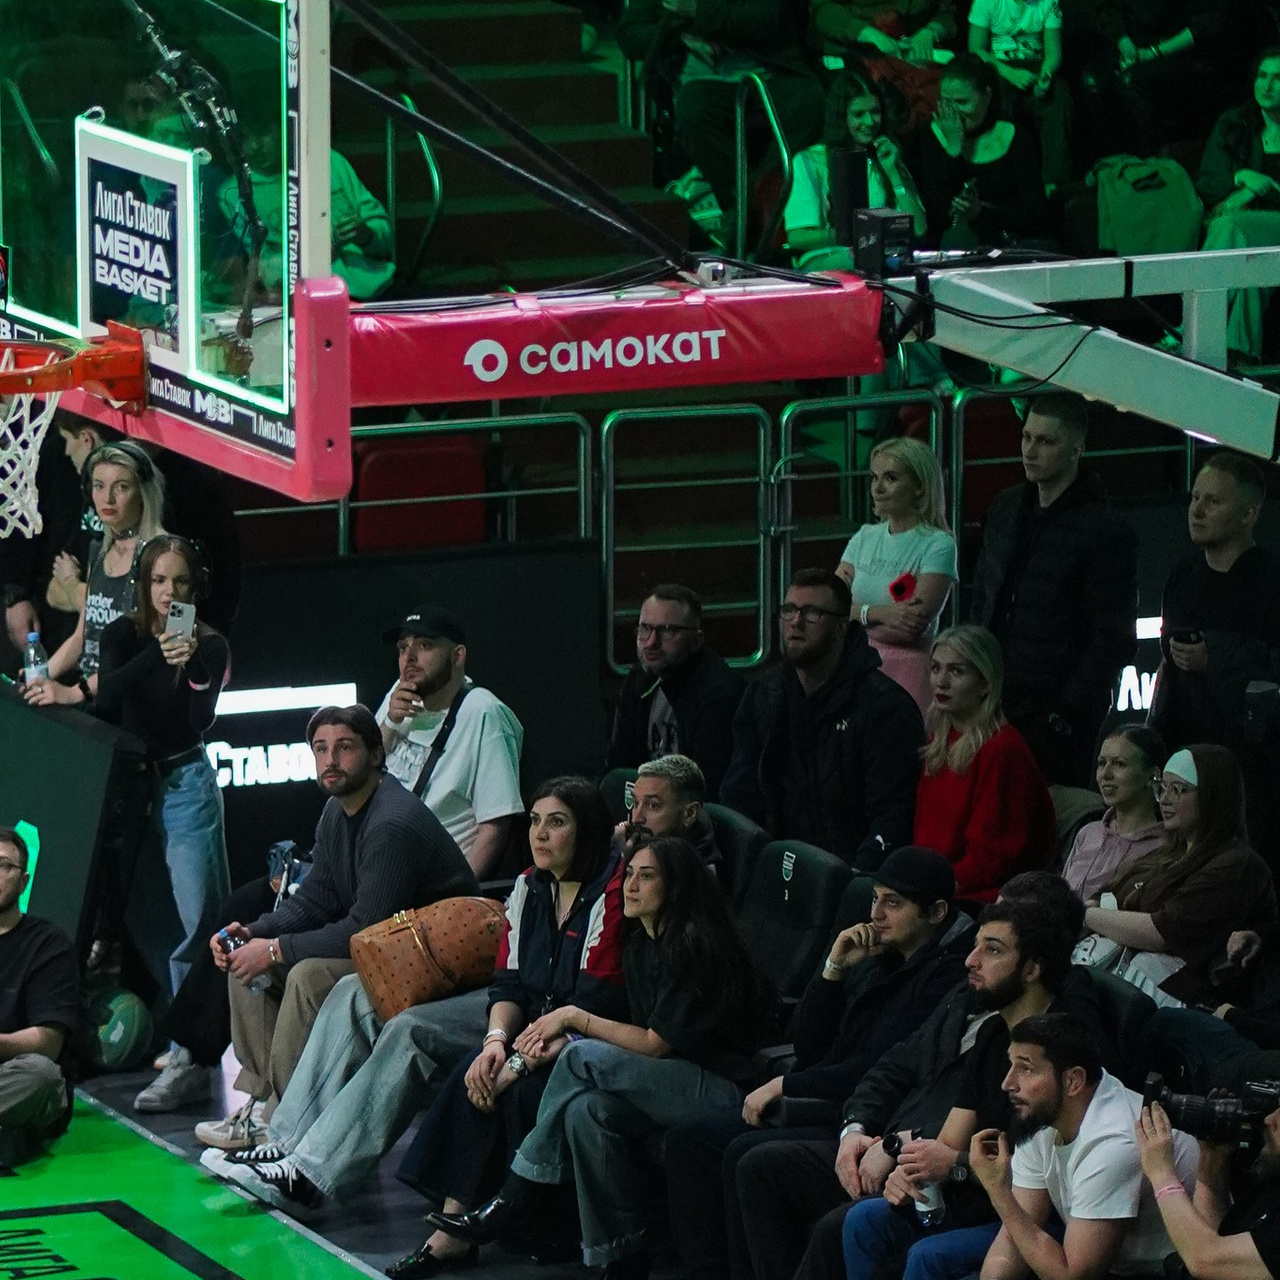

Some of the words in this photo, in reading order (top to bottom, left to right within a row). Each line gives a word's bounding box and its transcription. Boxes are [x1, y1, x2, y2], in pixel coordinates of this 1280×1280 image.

[94, 224, 170, 278] MEDIA
[95, 258, 172, 306] BASKET
[519, 329, 726, 376] самокат
